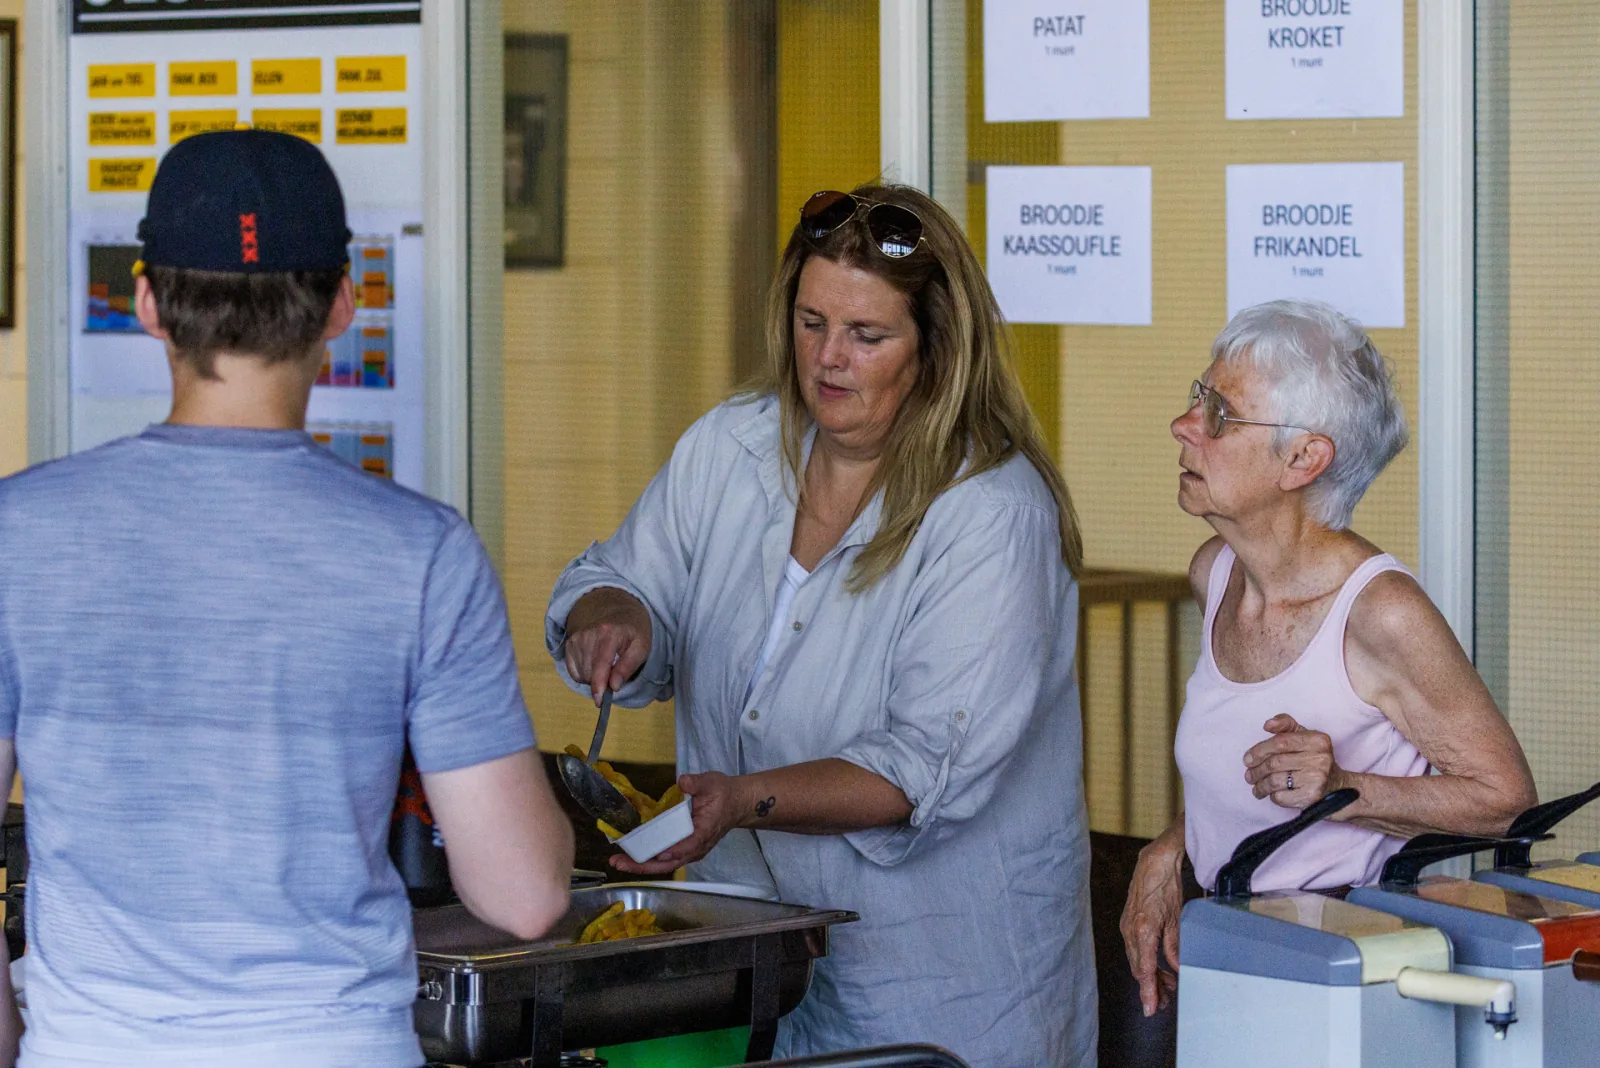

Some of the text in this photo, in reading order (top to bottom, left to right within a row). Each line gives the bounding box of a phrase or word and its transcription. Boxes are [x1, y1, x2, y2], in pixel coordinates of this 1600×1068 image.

[1261, 0, 1351, 18] BROODJE
[1033, 15, 1085, 37] PATAT
[1268, 26, 1344, 48] KROKET
[1044, 46, 1076, 57] 1 munt
[1290, 57, 1324, 69] 1 munt
[1020, 204, 1104, 226] BROODJE
[1262, 204, 1353, 226] BROODJE
[1003, 235, 1121, 257] KAASSOUFLE
[1254, 236, 1363, 257] FRIKANDEL
[1047, 263, 1077, 275] 1 munt
[1291, 265, 1325, 277] 1 munt
